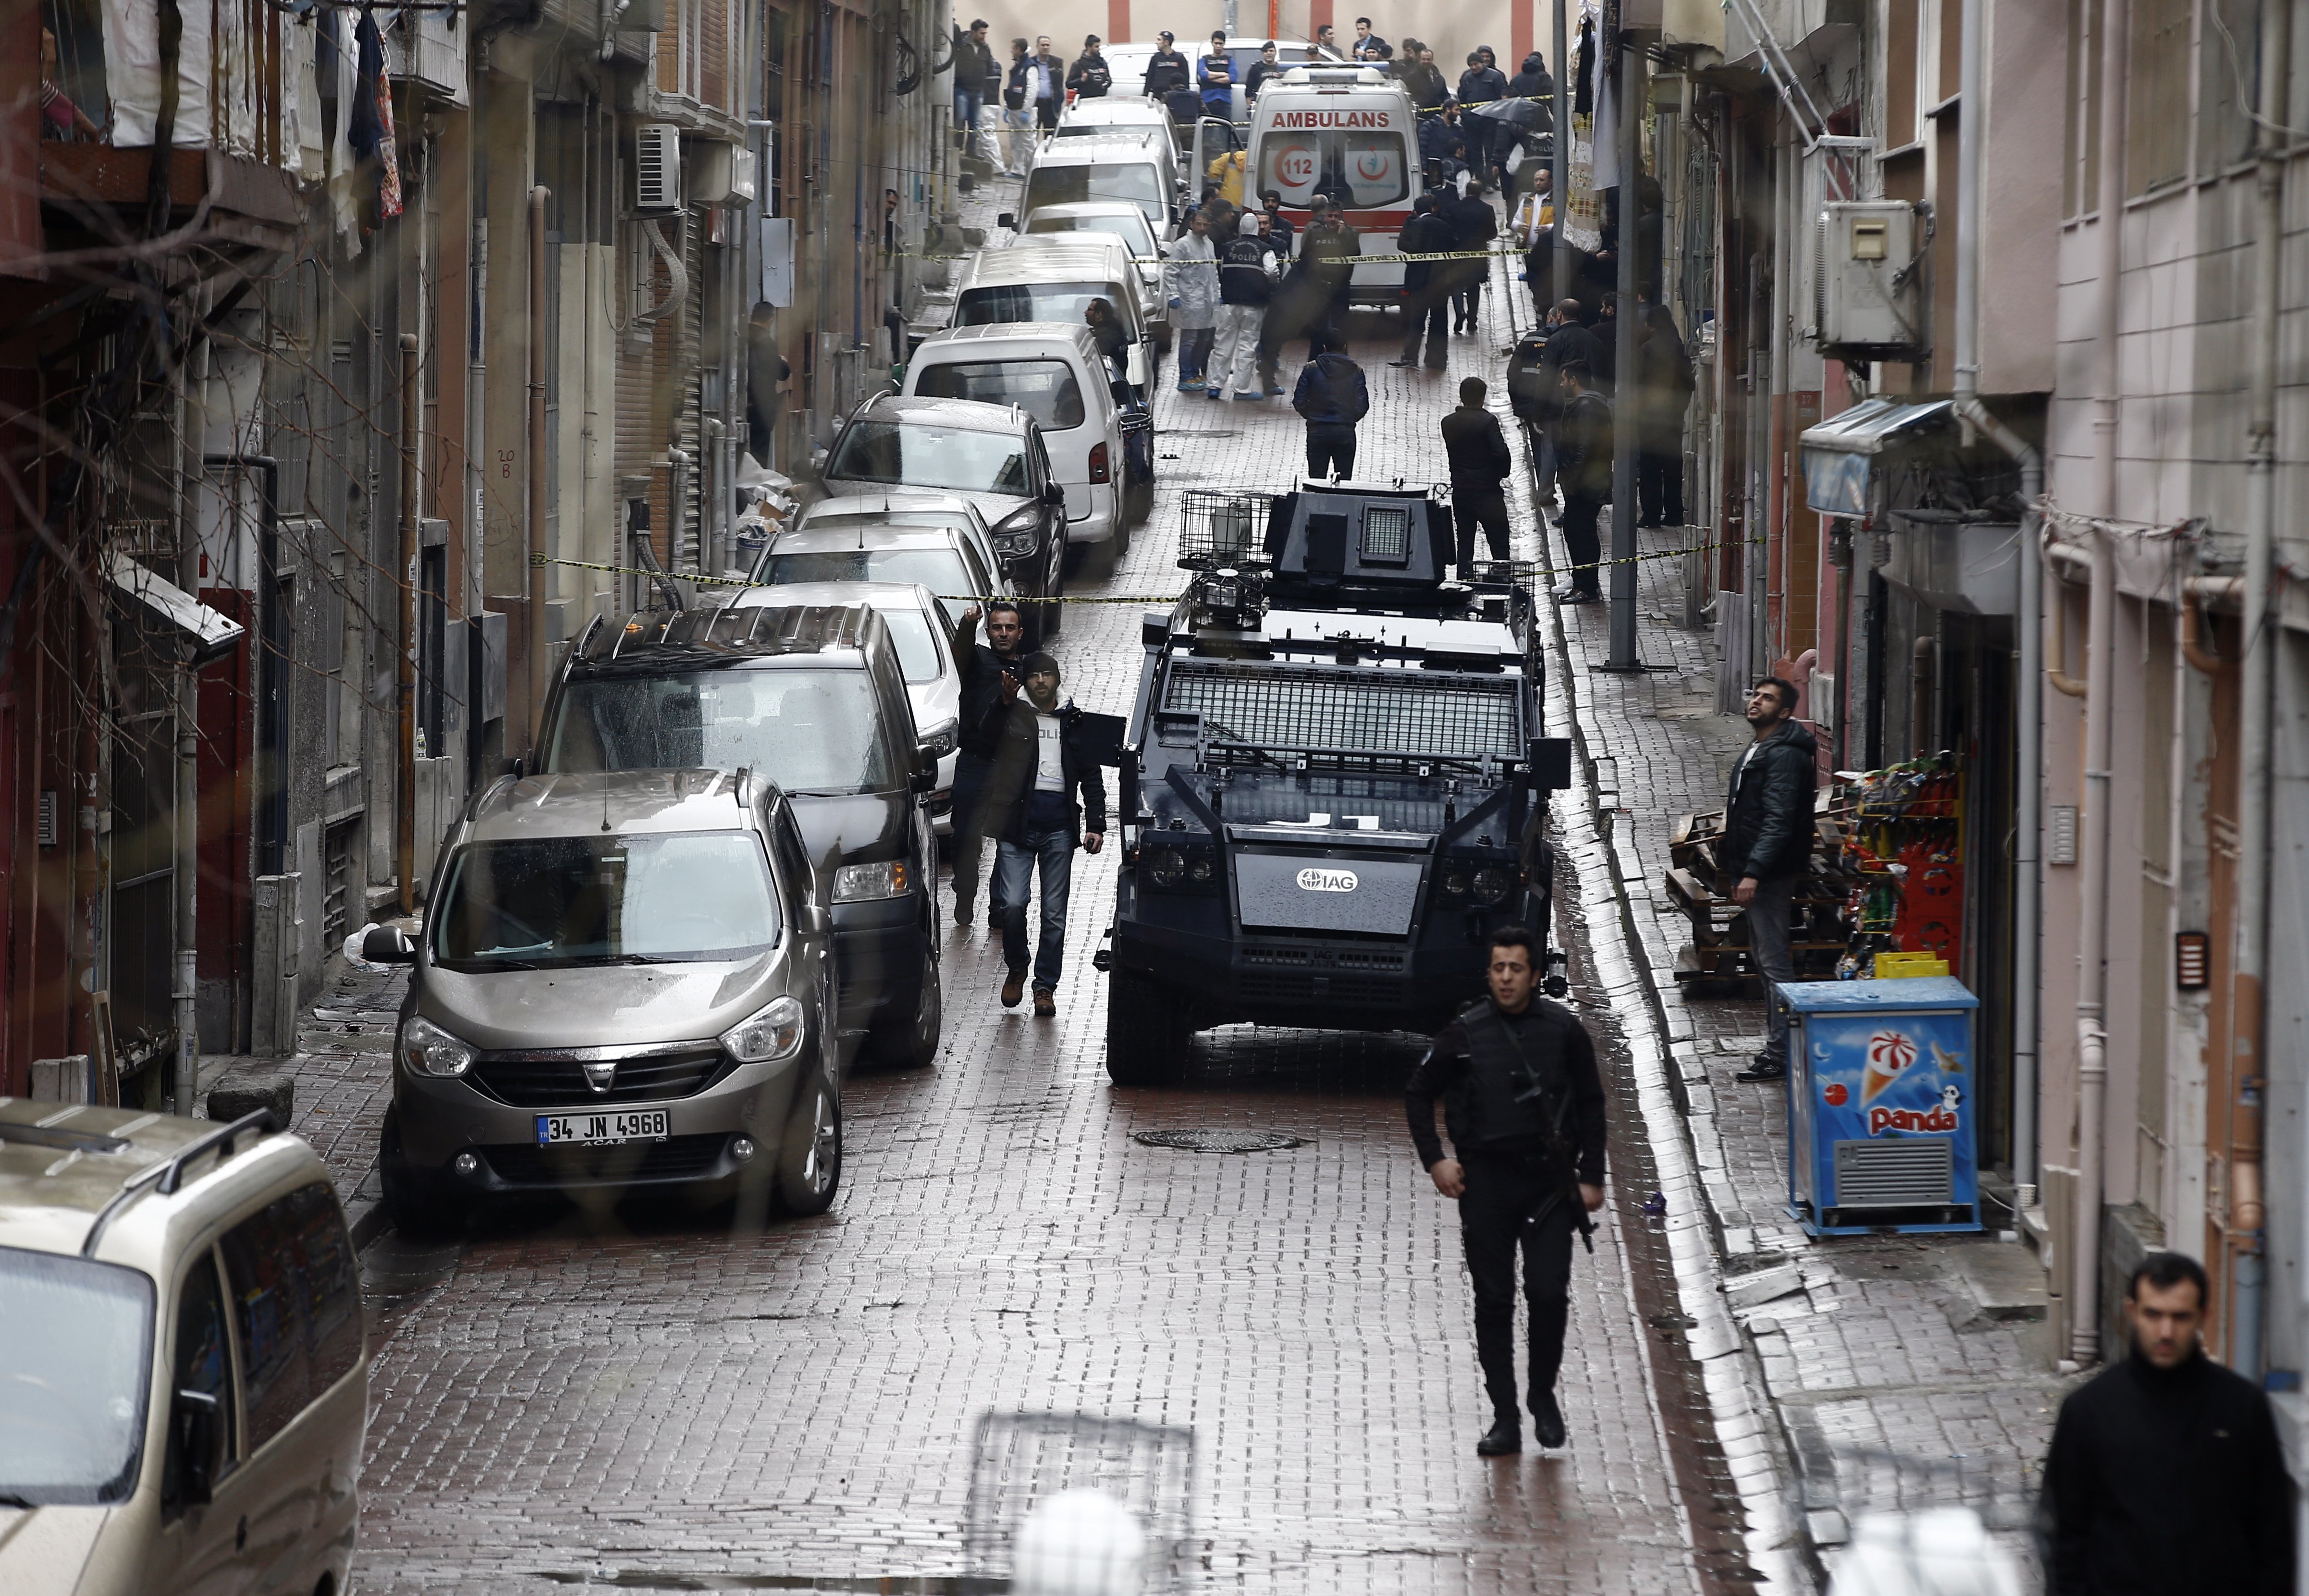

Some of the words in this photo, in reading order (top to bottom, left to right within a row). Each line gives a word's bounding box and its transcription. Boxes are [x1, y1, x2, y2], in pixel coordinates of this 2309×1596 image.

[1272, 111, 1390, 128] AMBULANS
[1284, 159, 1312, 174] 112
[1232, 252, 1257, 262] POLİS
[497, 449, 515, 462] 20
[502, 464, 511, 479] B
[1323, 875, 1354, 890] IAG
[549, 1118, 573, 1140] 34
[584, 1117, 607, 1138] JN
[617, 1113, 665, 1136] 4968
[1869, 1105, 1959, 1135] panda
[581, 1138, 627, 1147] ACAR
